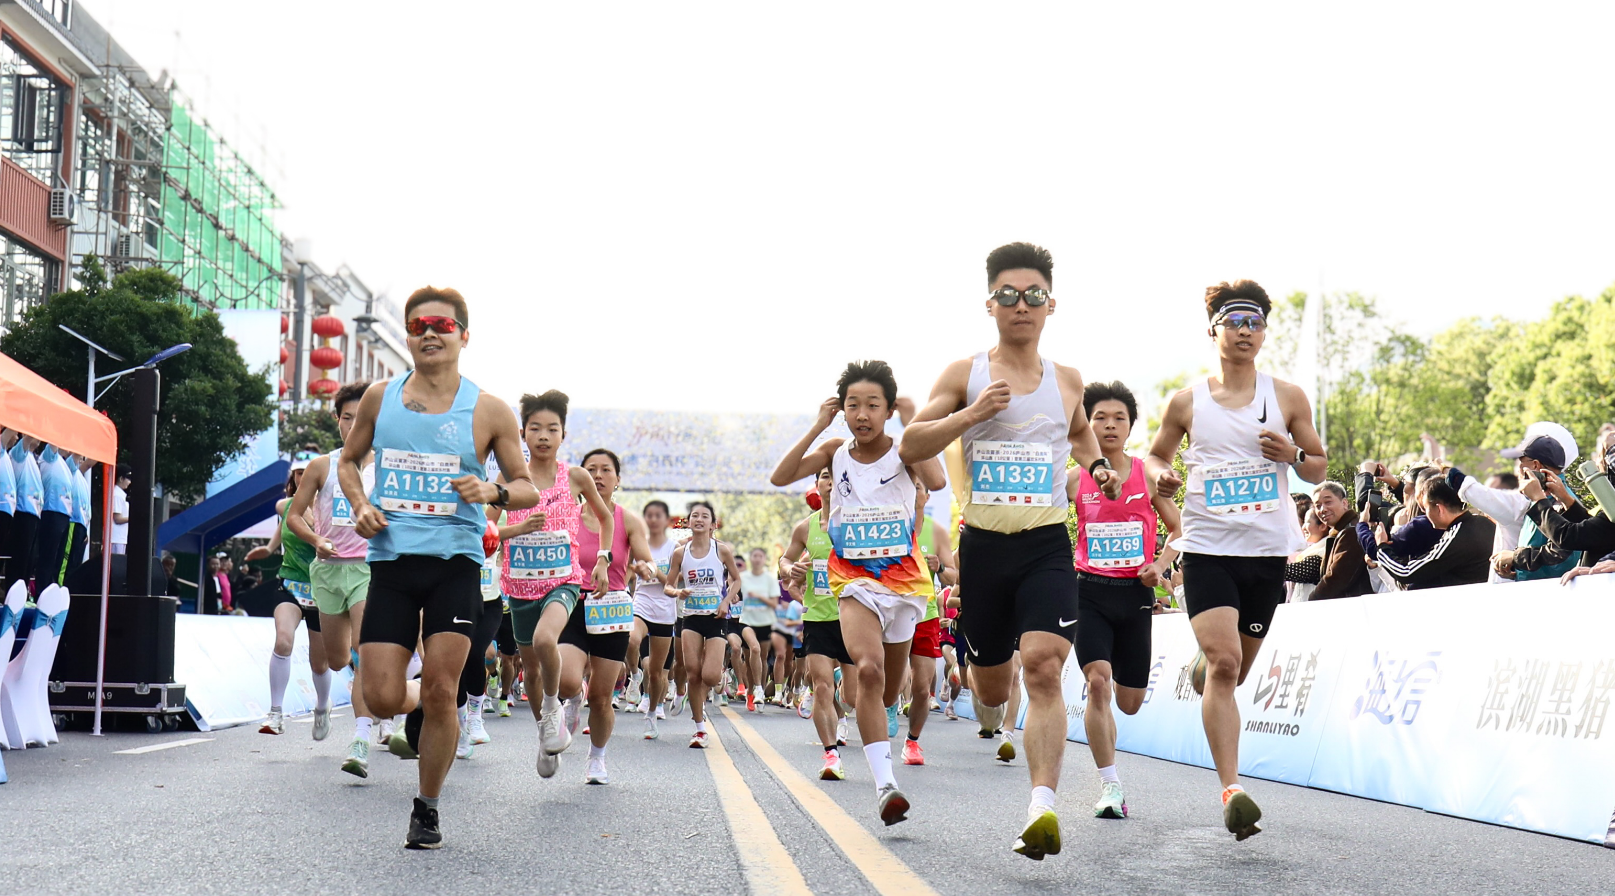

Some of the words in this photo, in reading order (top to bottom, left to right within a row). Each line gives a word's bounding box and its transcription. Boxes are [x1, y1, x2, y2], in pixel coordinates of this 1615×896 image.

[383, 470, 453, 494] A1132
[977, 463, 1048, 484] A1337
[1210, 476, 1274, 498] A1270
[844, 522, 902, 541] A1423
[1090, 537, 1140, 553] A1269
[513, 546, 567, 562] A1450
[687, 568, 715, 580] SJD
[287, 581, 311, 595] A13
[687, 596, 718, 606] A1449
[588, 604, 632, 620] A1008
[1476, 657, 1615, 740] 滨湖黑猪
[1244, 719, 1300, 737] SHANLIYAO
